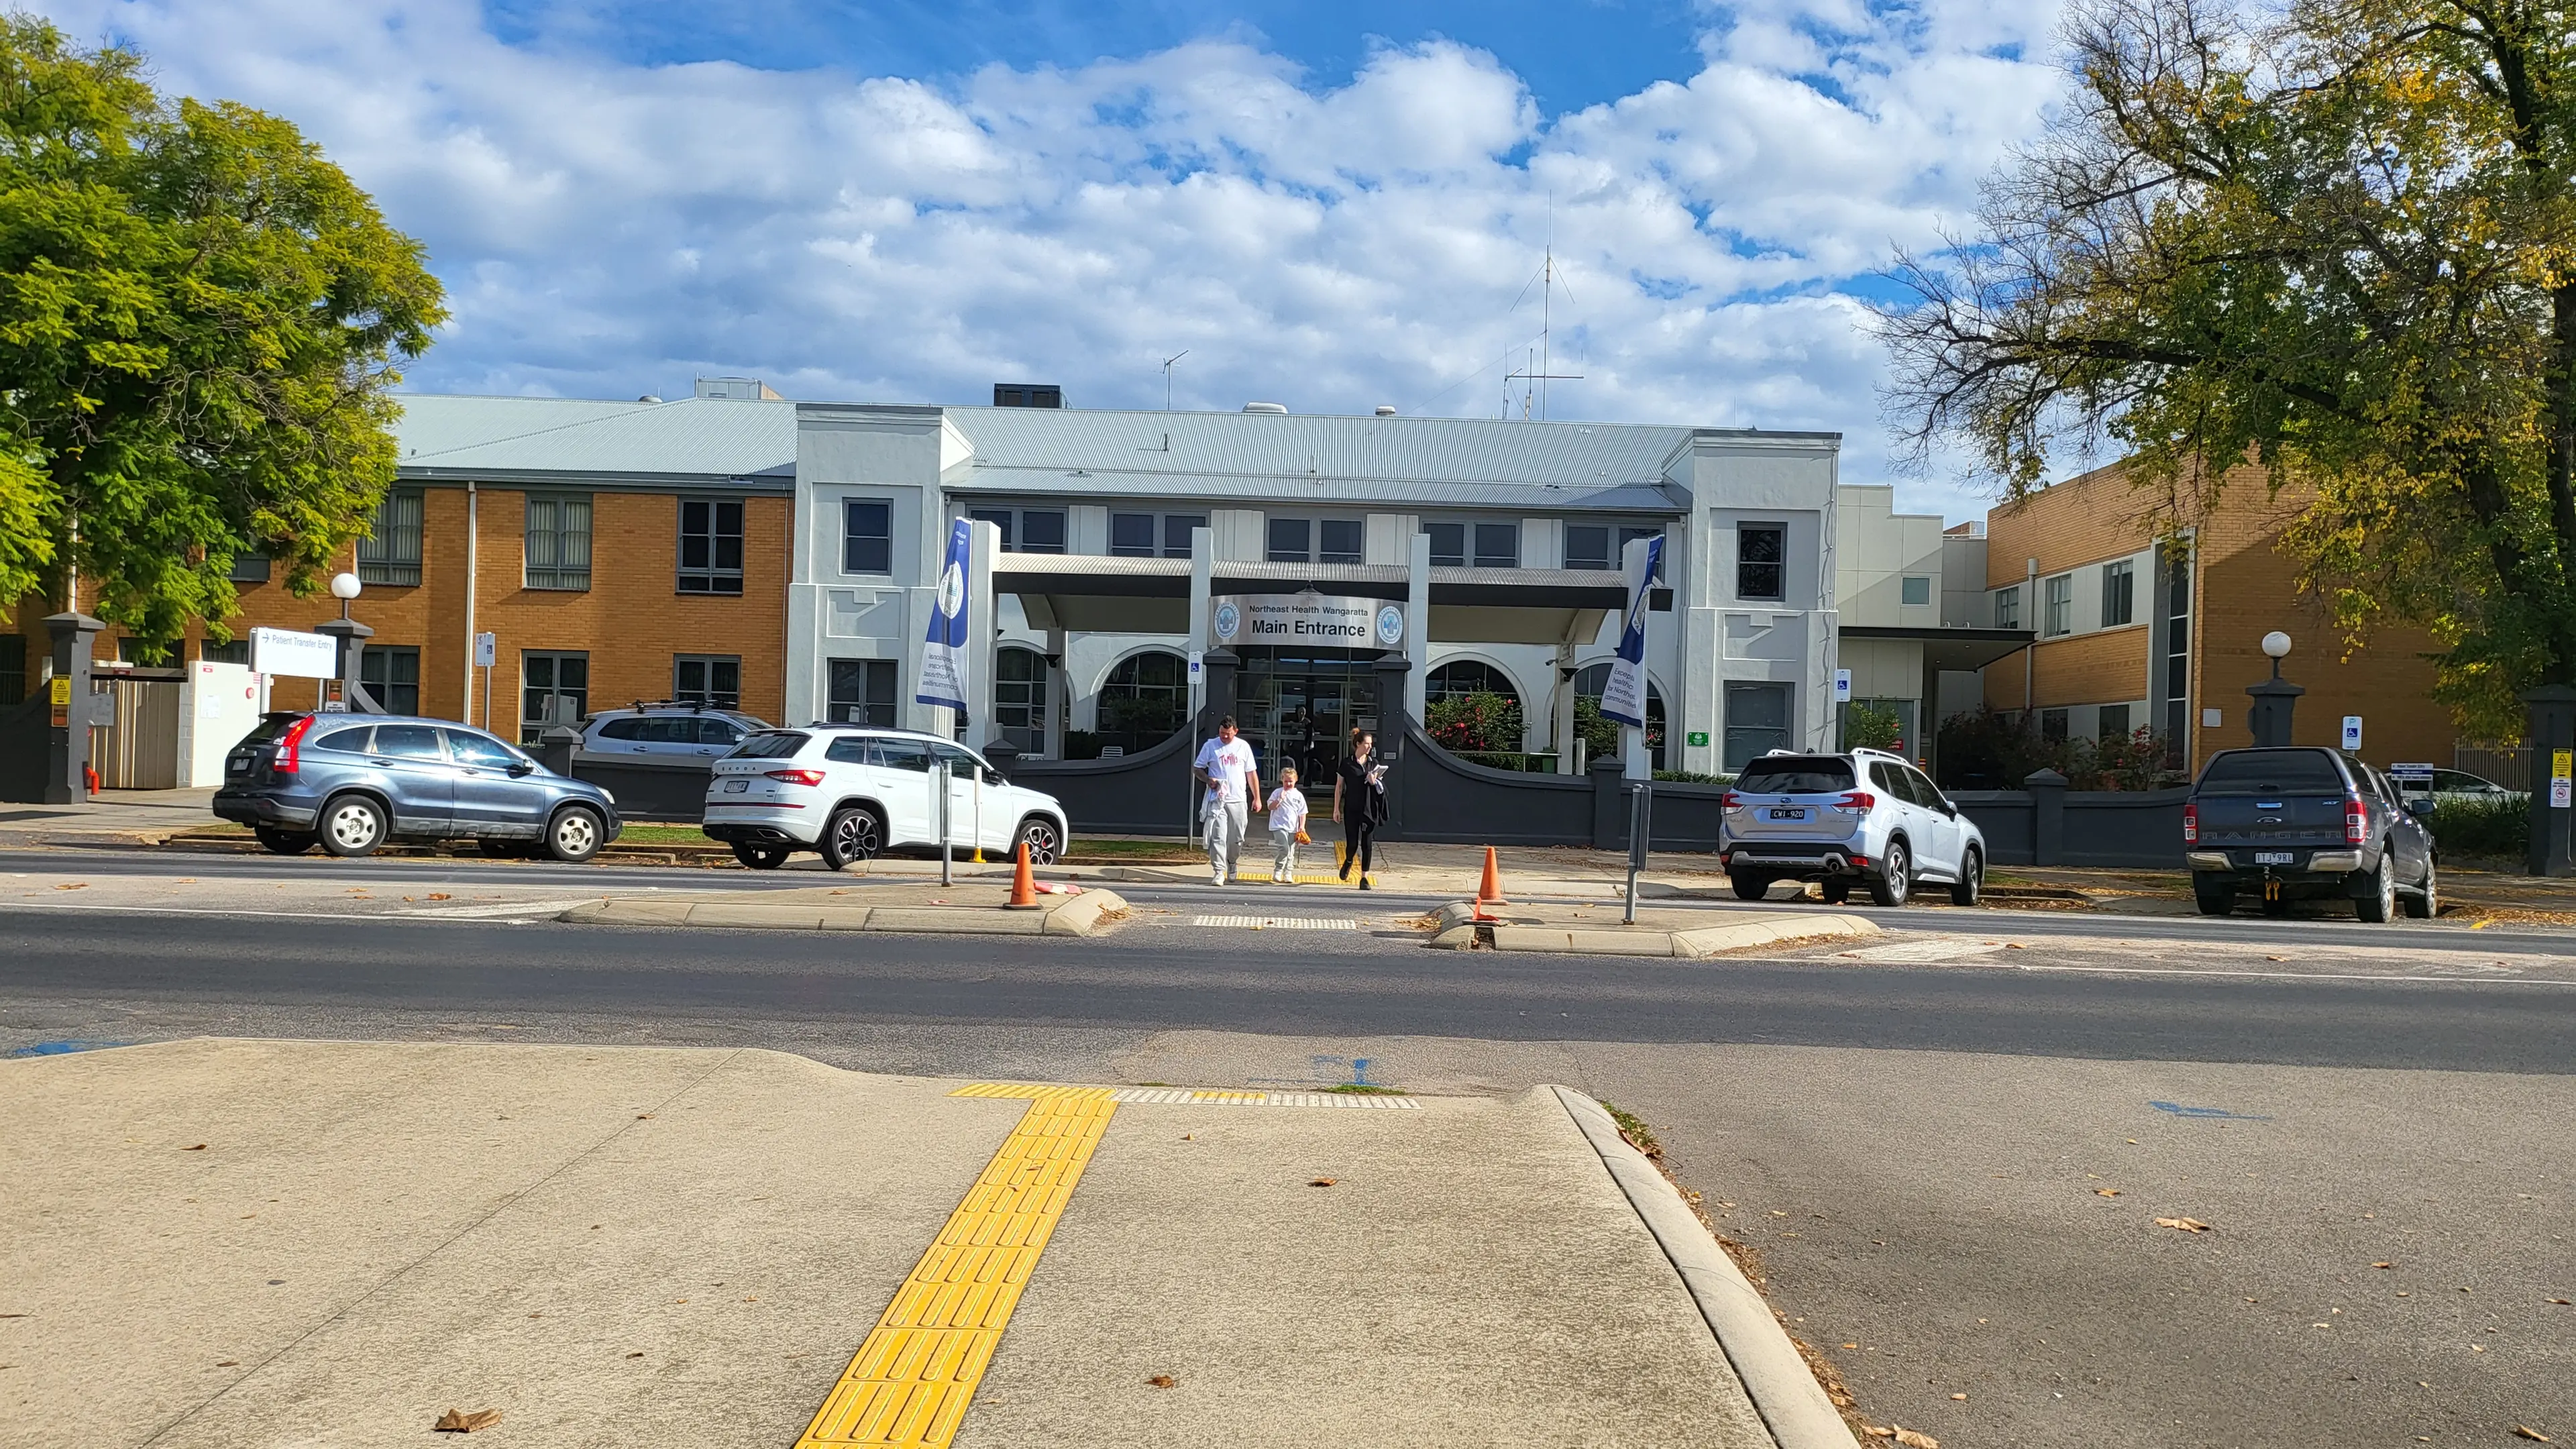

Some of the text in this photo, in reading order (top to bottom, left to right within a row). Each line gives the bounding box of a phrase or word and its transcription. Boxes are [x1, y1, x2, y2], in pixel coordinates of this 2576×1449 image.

[1249, 605, 1368, 616] Northeast Health Wangaratta
[1252, 620, 1366, 637] Main Entrance
[272, 635, 333, 651] Patient Transfer Entry
[2202, 831, 2342, 840] RANGER
